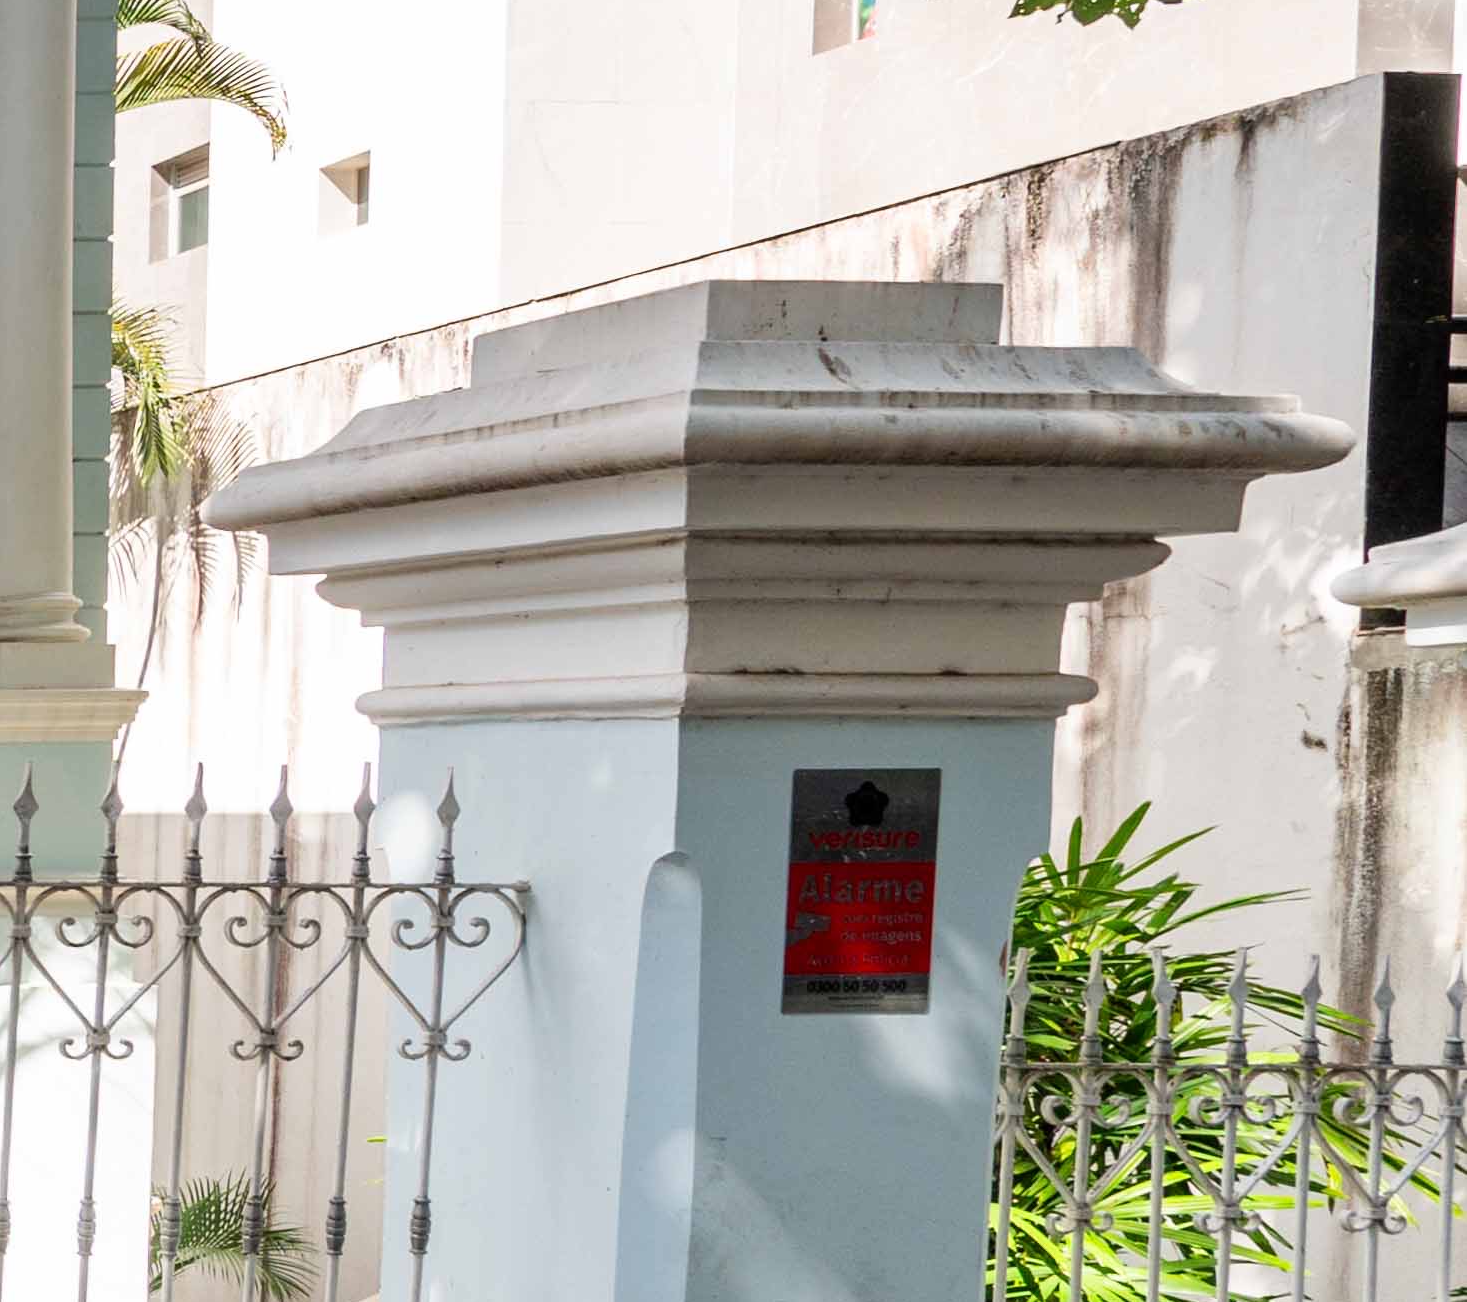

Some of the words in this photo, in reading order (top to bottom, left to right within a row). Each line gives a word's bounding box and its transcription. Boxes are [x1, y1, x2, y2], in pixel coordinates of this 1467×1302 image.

[809, 829, 921, 849] verisure
[799, 873, 924, 903] Alarme
[807, 980, 840, 993] 0300
[862, 980, 879, 992] 50
